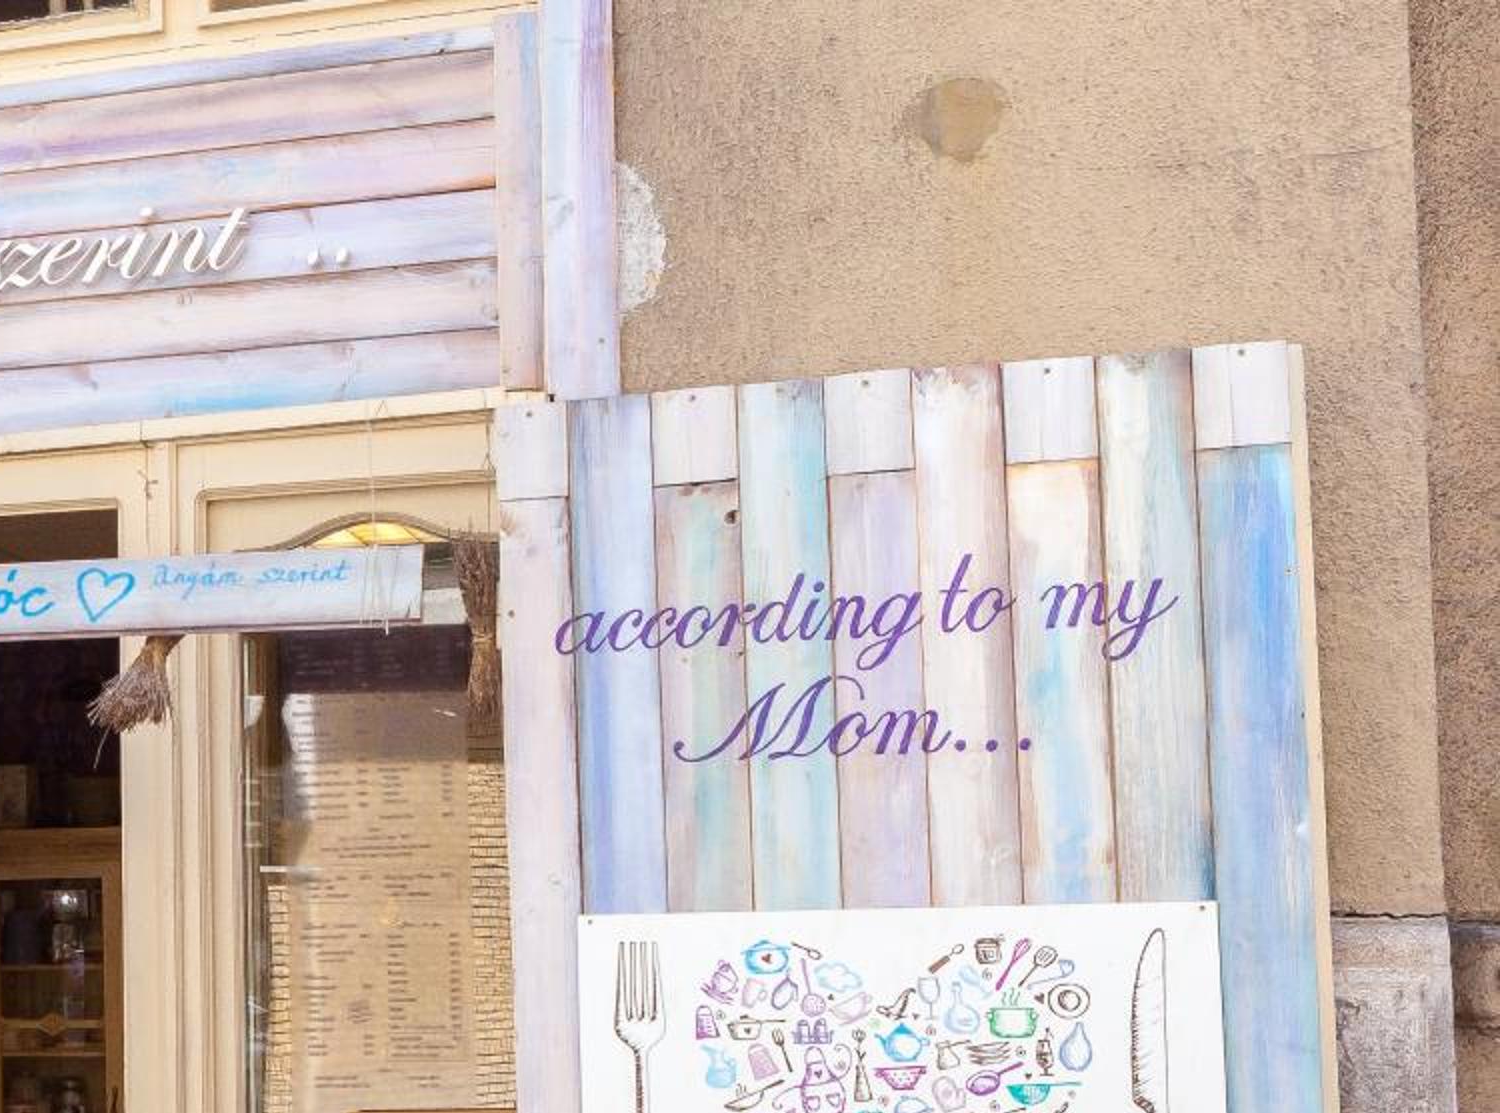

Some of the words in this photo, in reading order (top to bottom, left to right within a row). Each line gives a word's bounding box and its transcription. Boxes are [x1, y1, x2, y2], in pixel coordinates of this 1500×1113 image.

[554, 573, 927, 671] according
[939, 553, 1015, 634] to
[1041, 576, 1179, 662] my
[672, 674, 1033, 763] Mom...
